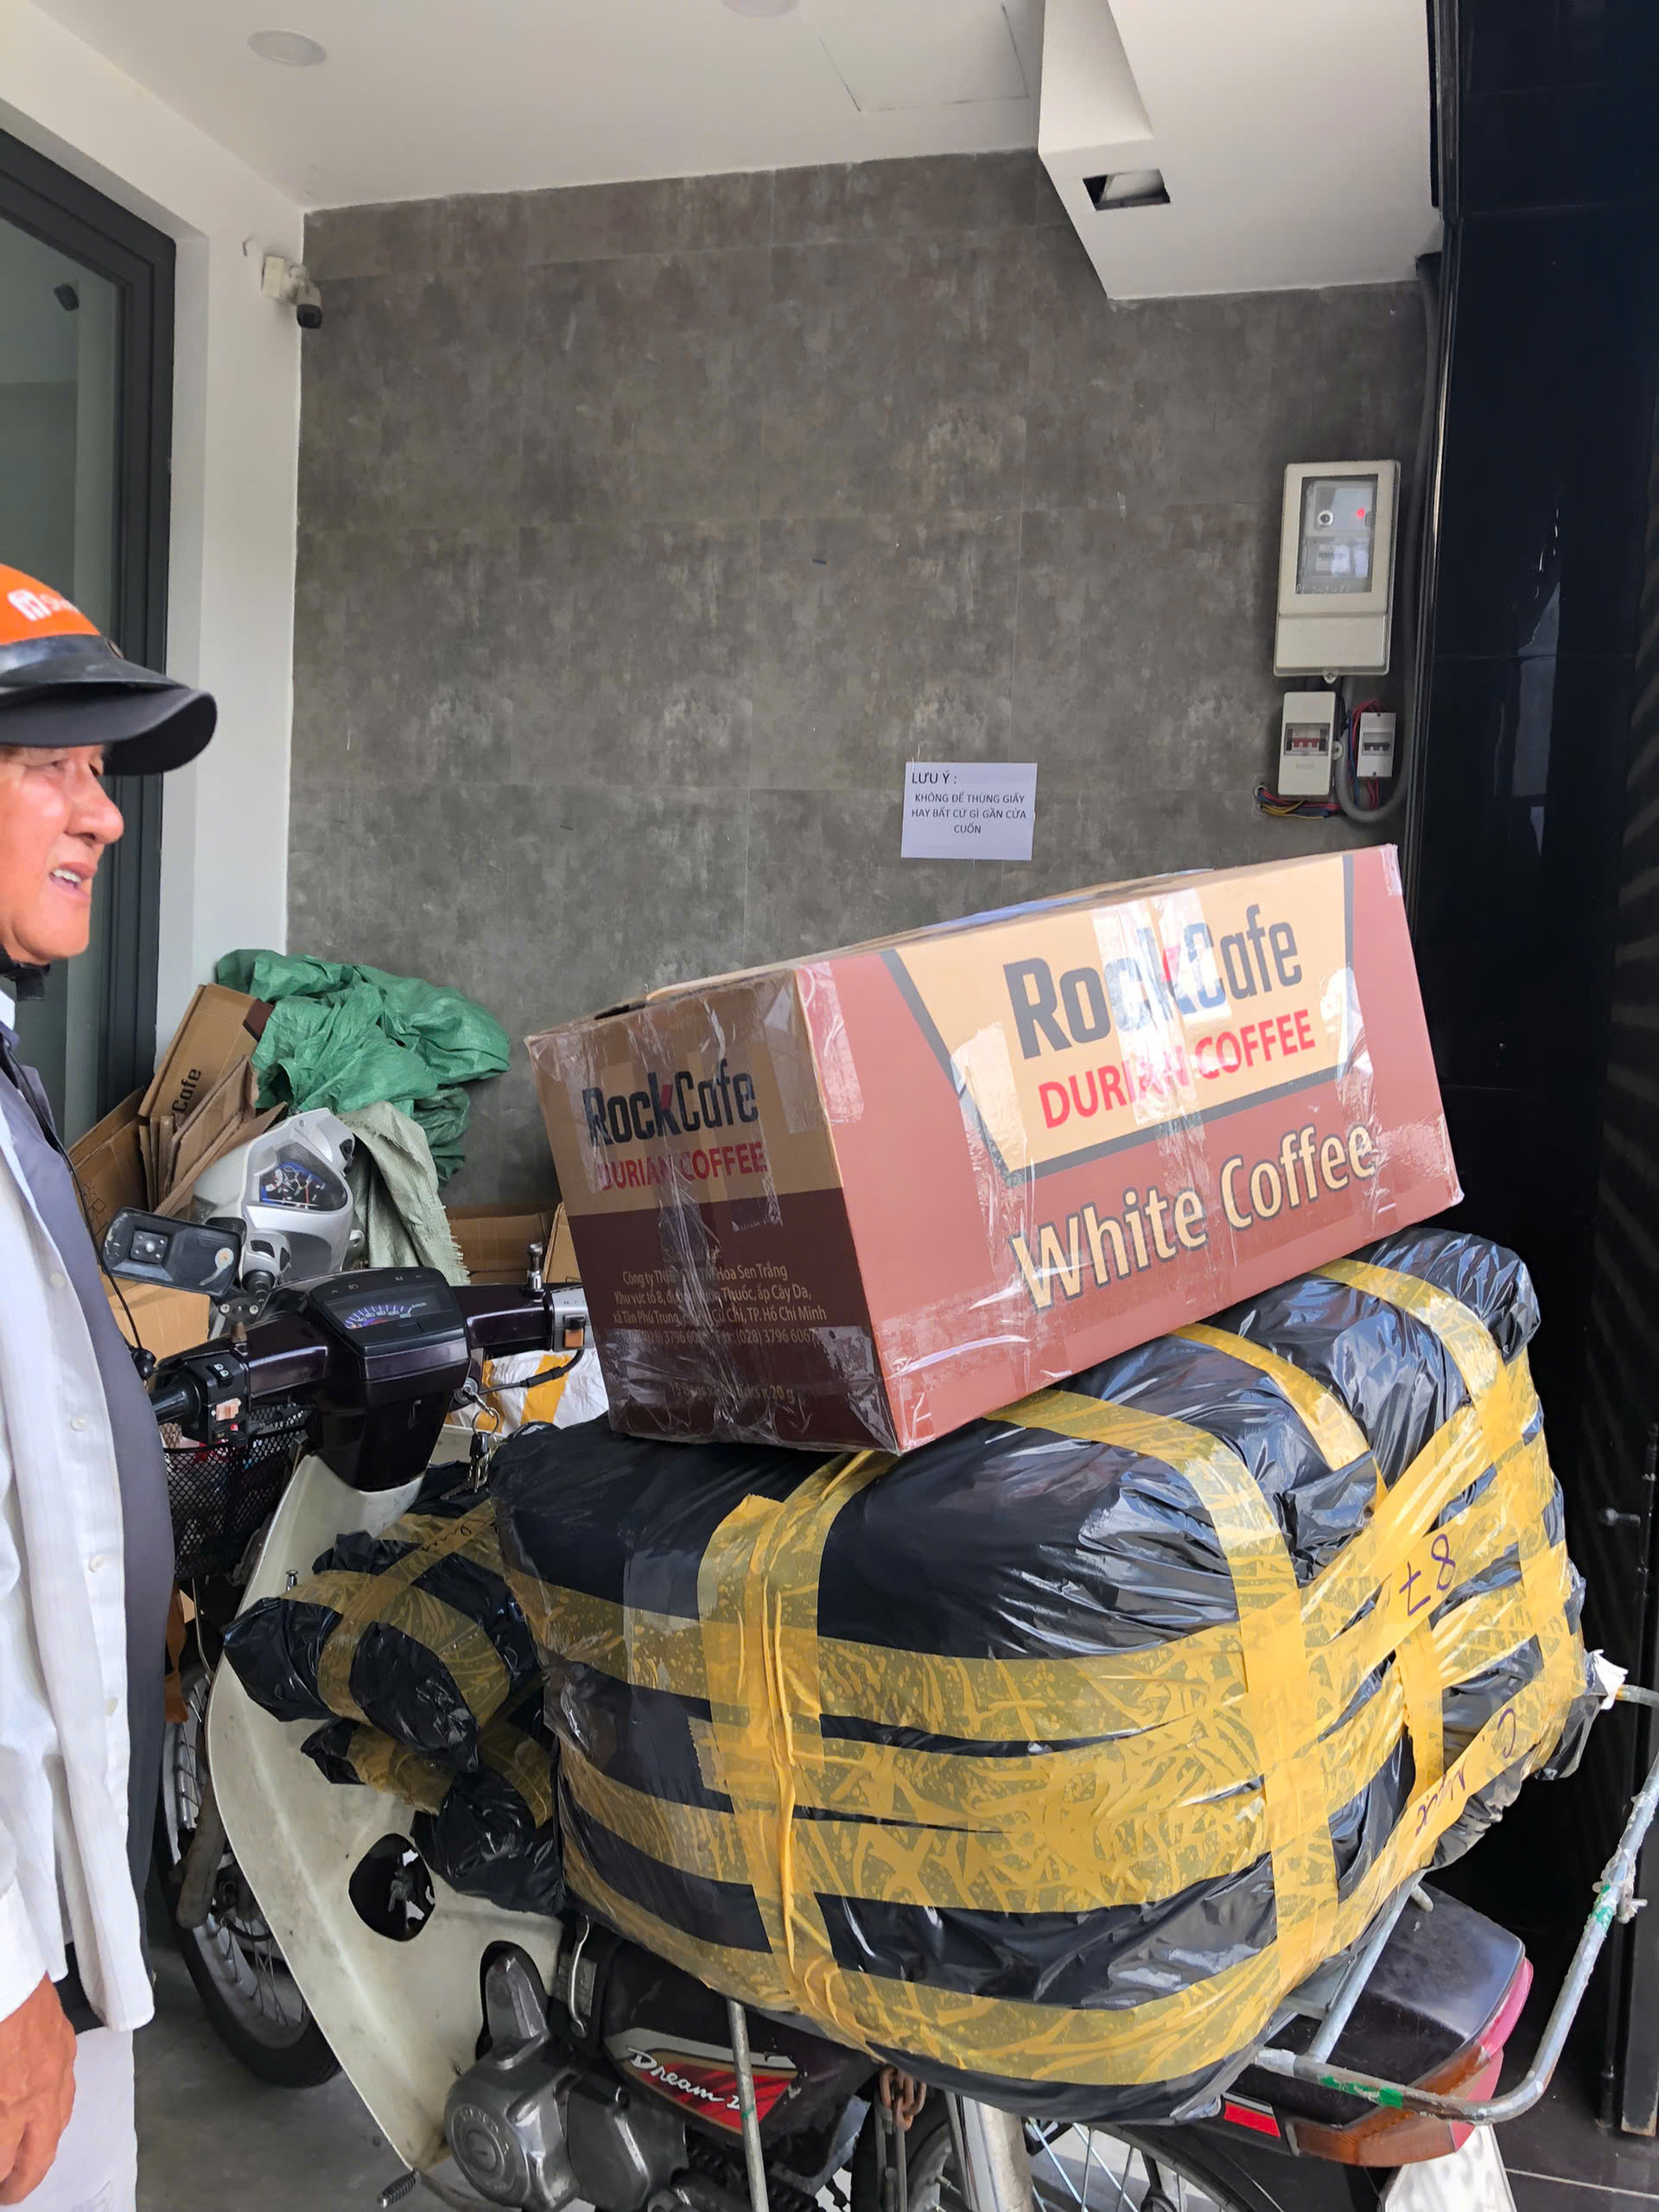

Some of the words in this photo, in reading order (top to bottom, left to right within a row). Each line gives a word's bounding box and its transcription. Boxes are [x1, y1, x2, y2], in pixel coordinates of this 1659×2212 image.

[912, 771, 938, 785] LƯU
[943, 770, 950, 785] Ý
[914, 791, 949, 803] KHÔNG
[967, 792, 1000, 804] THÙNG
[1002, 792, 1026, 804] GIẤY
[912, 809, 931, 817] HAY
[932, 806, 950, 818] BẤT
[952, 807, 968, 819] CỨ
[969, 808, 980, 819] GÌ
[982, 806, 1003, 819] GẦN
[1006, 808, 1027, 820] CỬA
[953, 822, 982, 835] CUỐN
[1038, 1046, 1190, 1130] DURIAN
[1193, 1007, 1317, 1081] COFFEE
[582, 1058, 760, 1148] RockCafe
[597, 1154, 674, 1191] DURIAN
[679, 1141, 769, 1181] COFFEE
[1009, 1187, 1209, 1313] White
[1220, 1123, 1377, 1232] Coffee
[622, 1271, 645, 1288] Công
[646, 1271, 654, 1290] ty
[716, 1266, 737, 1281] Hoa
[737, 1264, 758, 1281] Sen
[756, 1260, 788, 1281] Trắng
[614, 1291, 631, 1306] Khu
[658, 1290, 666, 1306] 8,
[721, 1283, 757, 1303] Thuốc,
[757, 1284, 770, 1304] ấp
[771, 1283, 791, 1304] Cây
[791, 1283, 812, 1301] Da,
[622, 1309, 637, 1325] Tân
[637, 1309, 654, 1325] Phú
[747, 1306, 762, 1323] TP.
[762, 1304, 779, 1322] Hồ
[798, 1303, 828, 1321] Minh
[736, 1328, 763, 1345] (028)
[763, 1328, 790, 1344] 3796
[1399, 1534, 1456, 1617] 87
[626, 2046, 726, 2102] Dream
